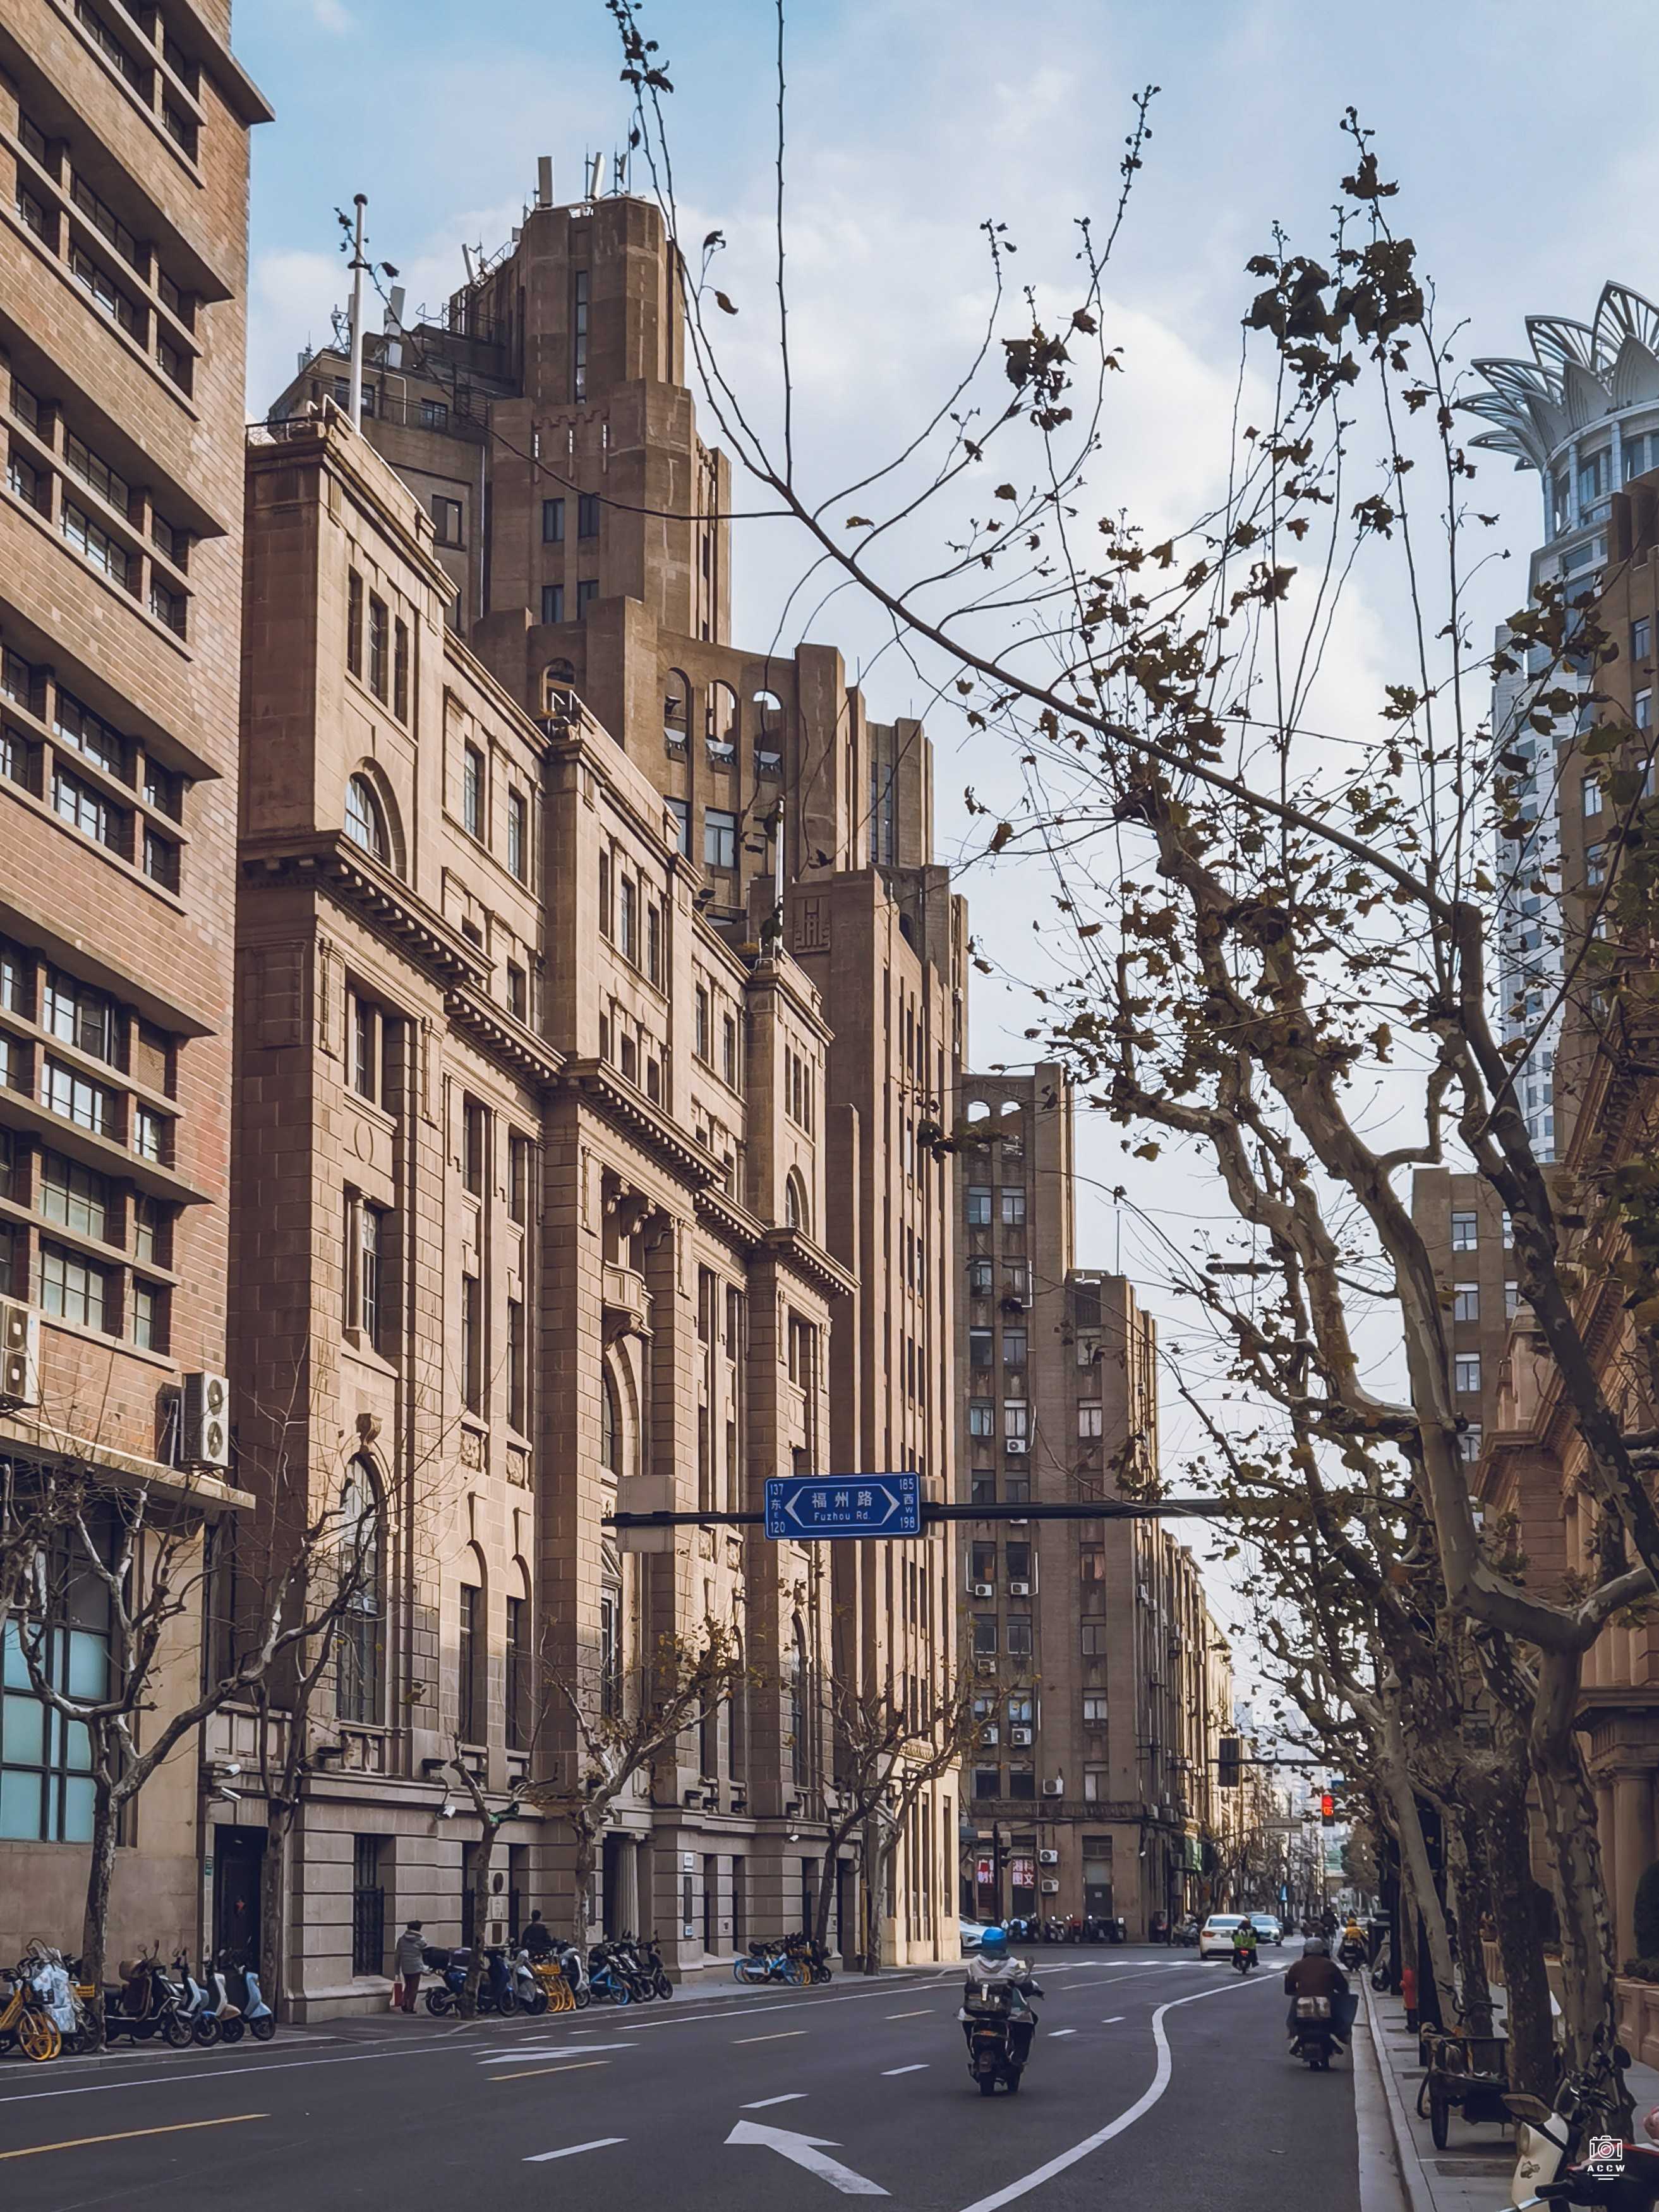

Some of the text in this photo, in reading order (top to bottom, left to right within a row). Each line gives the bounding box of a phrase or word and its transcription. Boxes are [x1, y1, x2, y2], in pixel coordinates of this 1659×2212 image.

[770, 1484, 783, 1496] 137
[900, 1478, 914, 1490] 185
[812, 1490, 873, 1508] 福州路
[903, 1494, 914, 1505] 西
[770, 1500, 781, 1511] 东
[814, 1511, 871, 1521] Fuzhou Rd.
[771, 1521, 785, 1533] 120
[900, 1516, 915, 1529] 198
